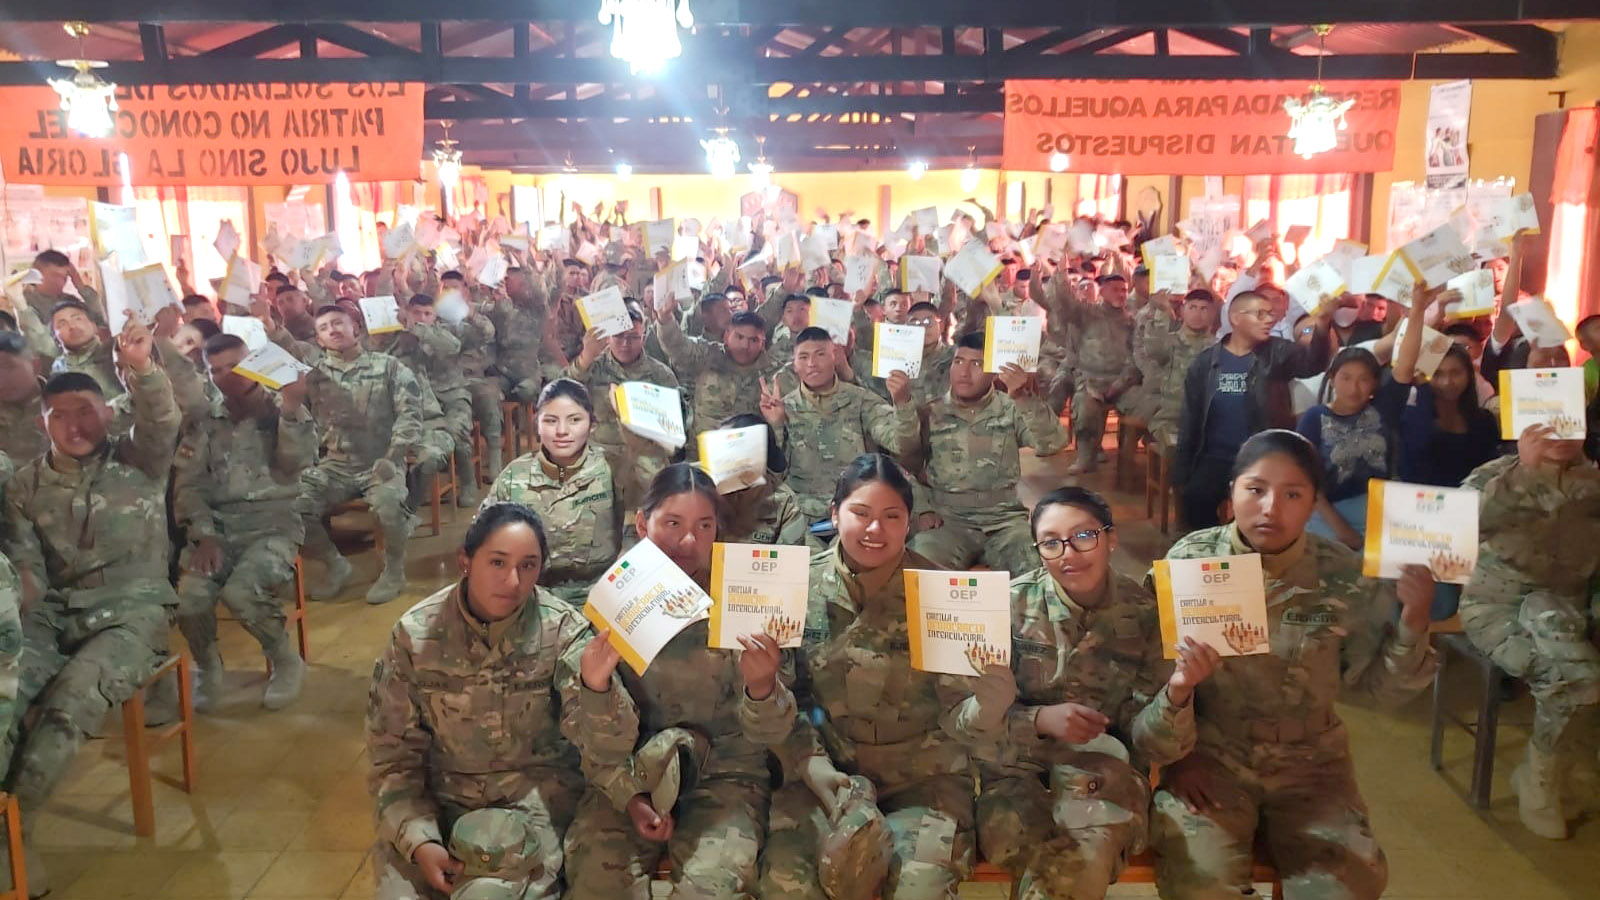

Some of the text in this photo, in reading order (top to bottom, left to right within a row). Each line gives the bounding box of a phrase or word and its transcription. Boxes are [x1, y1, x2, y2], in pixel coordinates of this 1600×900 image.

[752, 561, 778, 572] OEP
[616, 568, 636, 590] OEP
[1203, 573, 1231, 584] OEP
[950, 589, 978, 600] OEP
[1182, 614, 1243, 625] INTERCULTURAL
[927, 629, 986, 643] INTERCULTURAL
